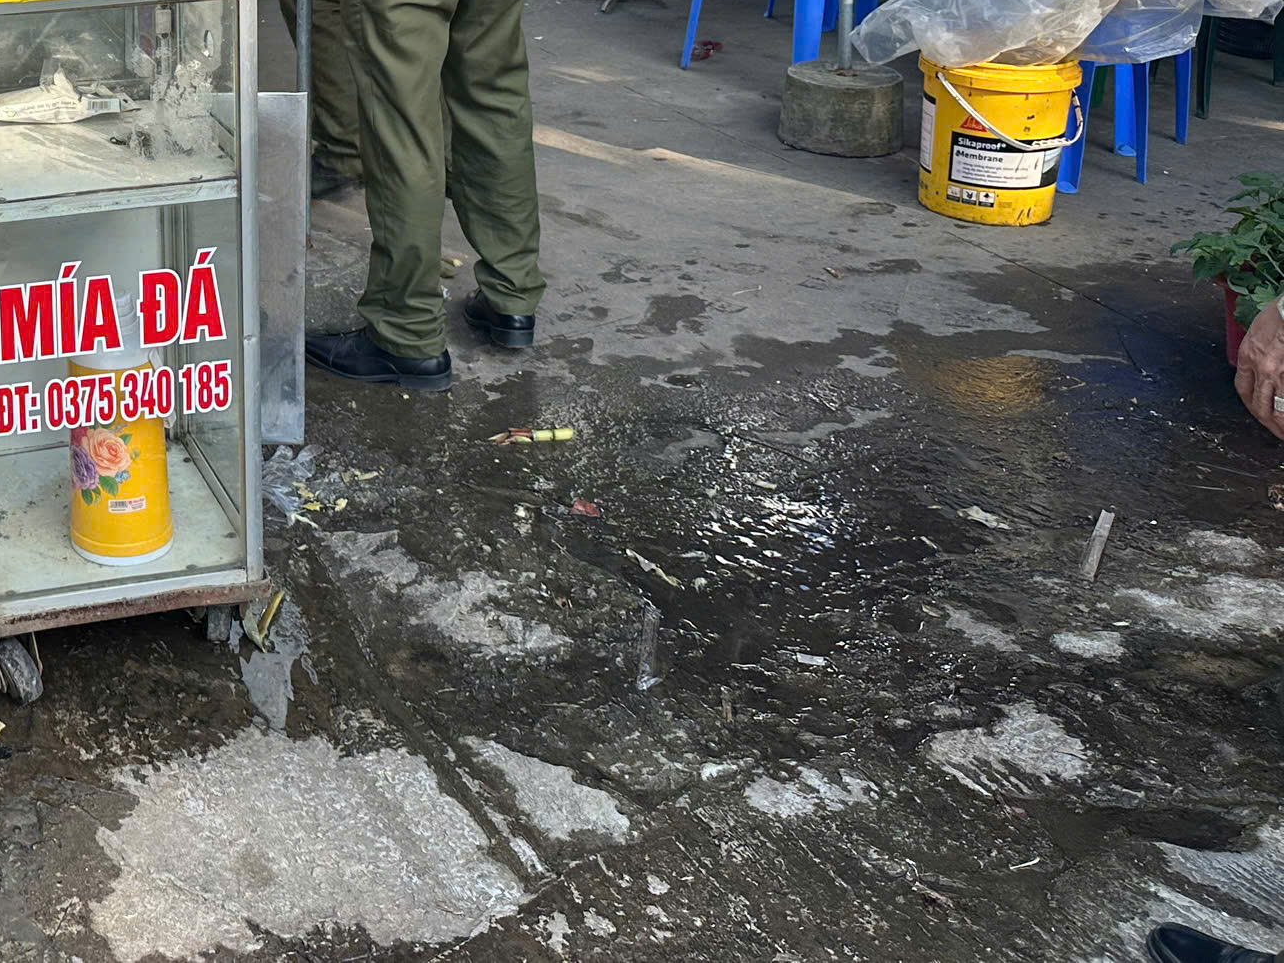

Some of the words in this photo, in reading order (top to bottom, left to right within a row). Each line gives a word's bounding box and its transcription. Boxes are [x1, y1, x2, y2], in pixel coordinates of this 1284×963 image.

[957, 150, 1004, 163] Membrane
[136, 247, 227, 348] ĐÁ
[46, 373, 117, 429] 0375
[121, 368, 175, 421] 340
[179, 361, 233, 414] 185
